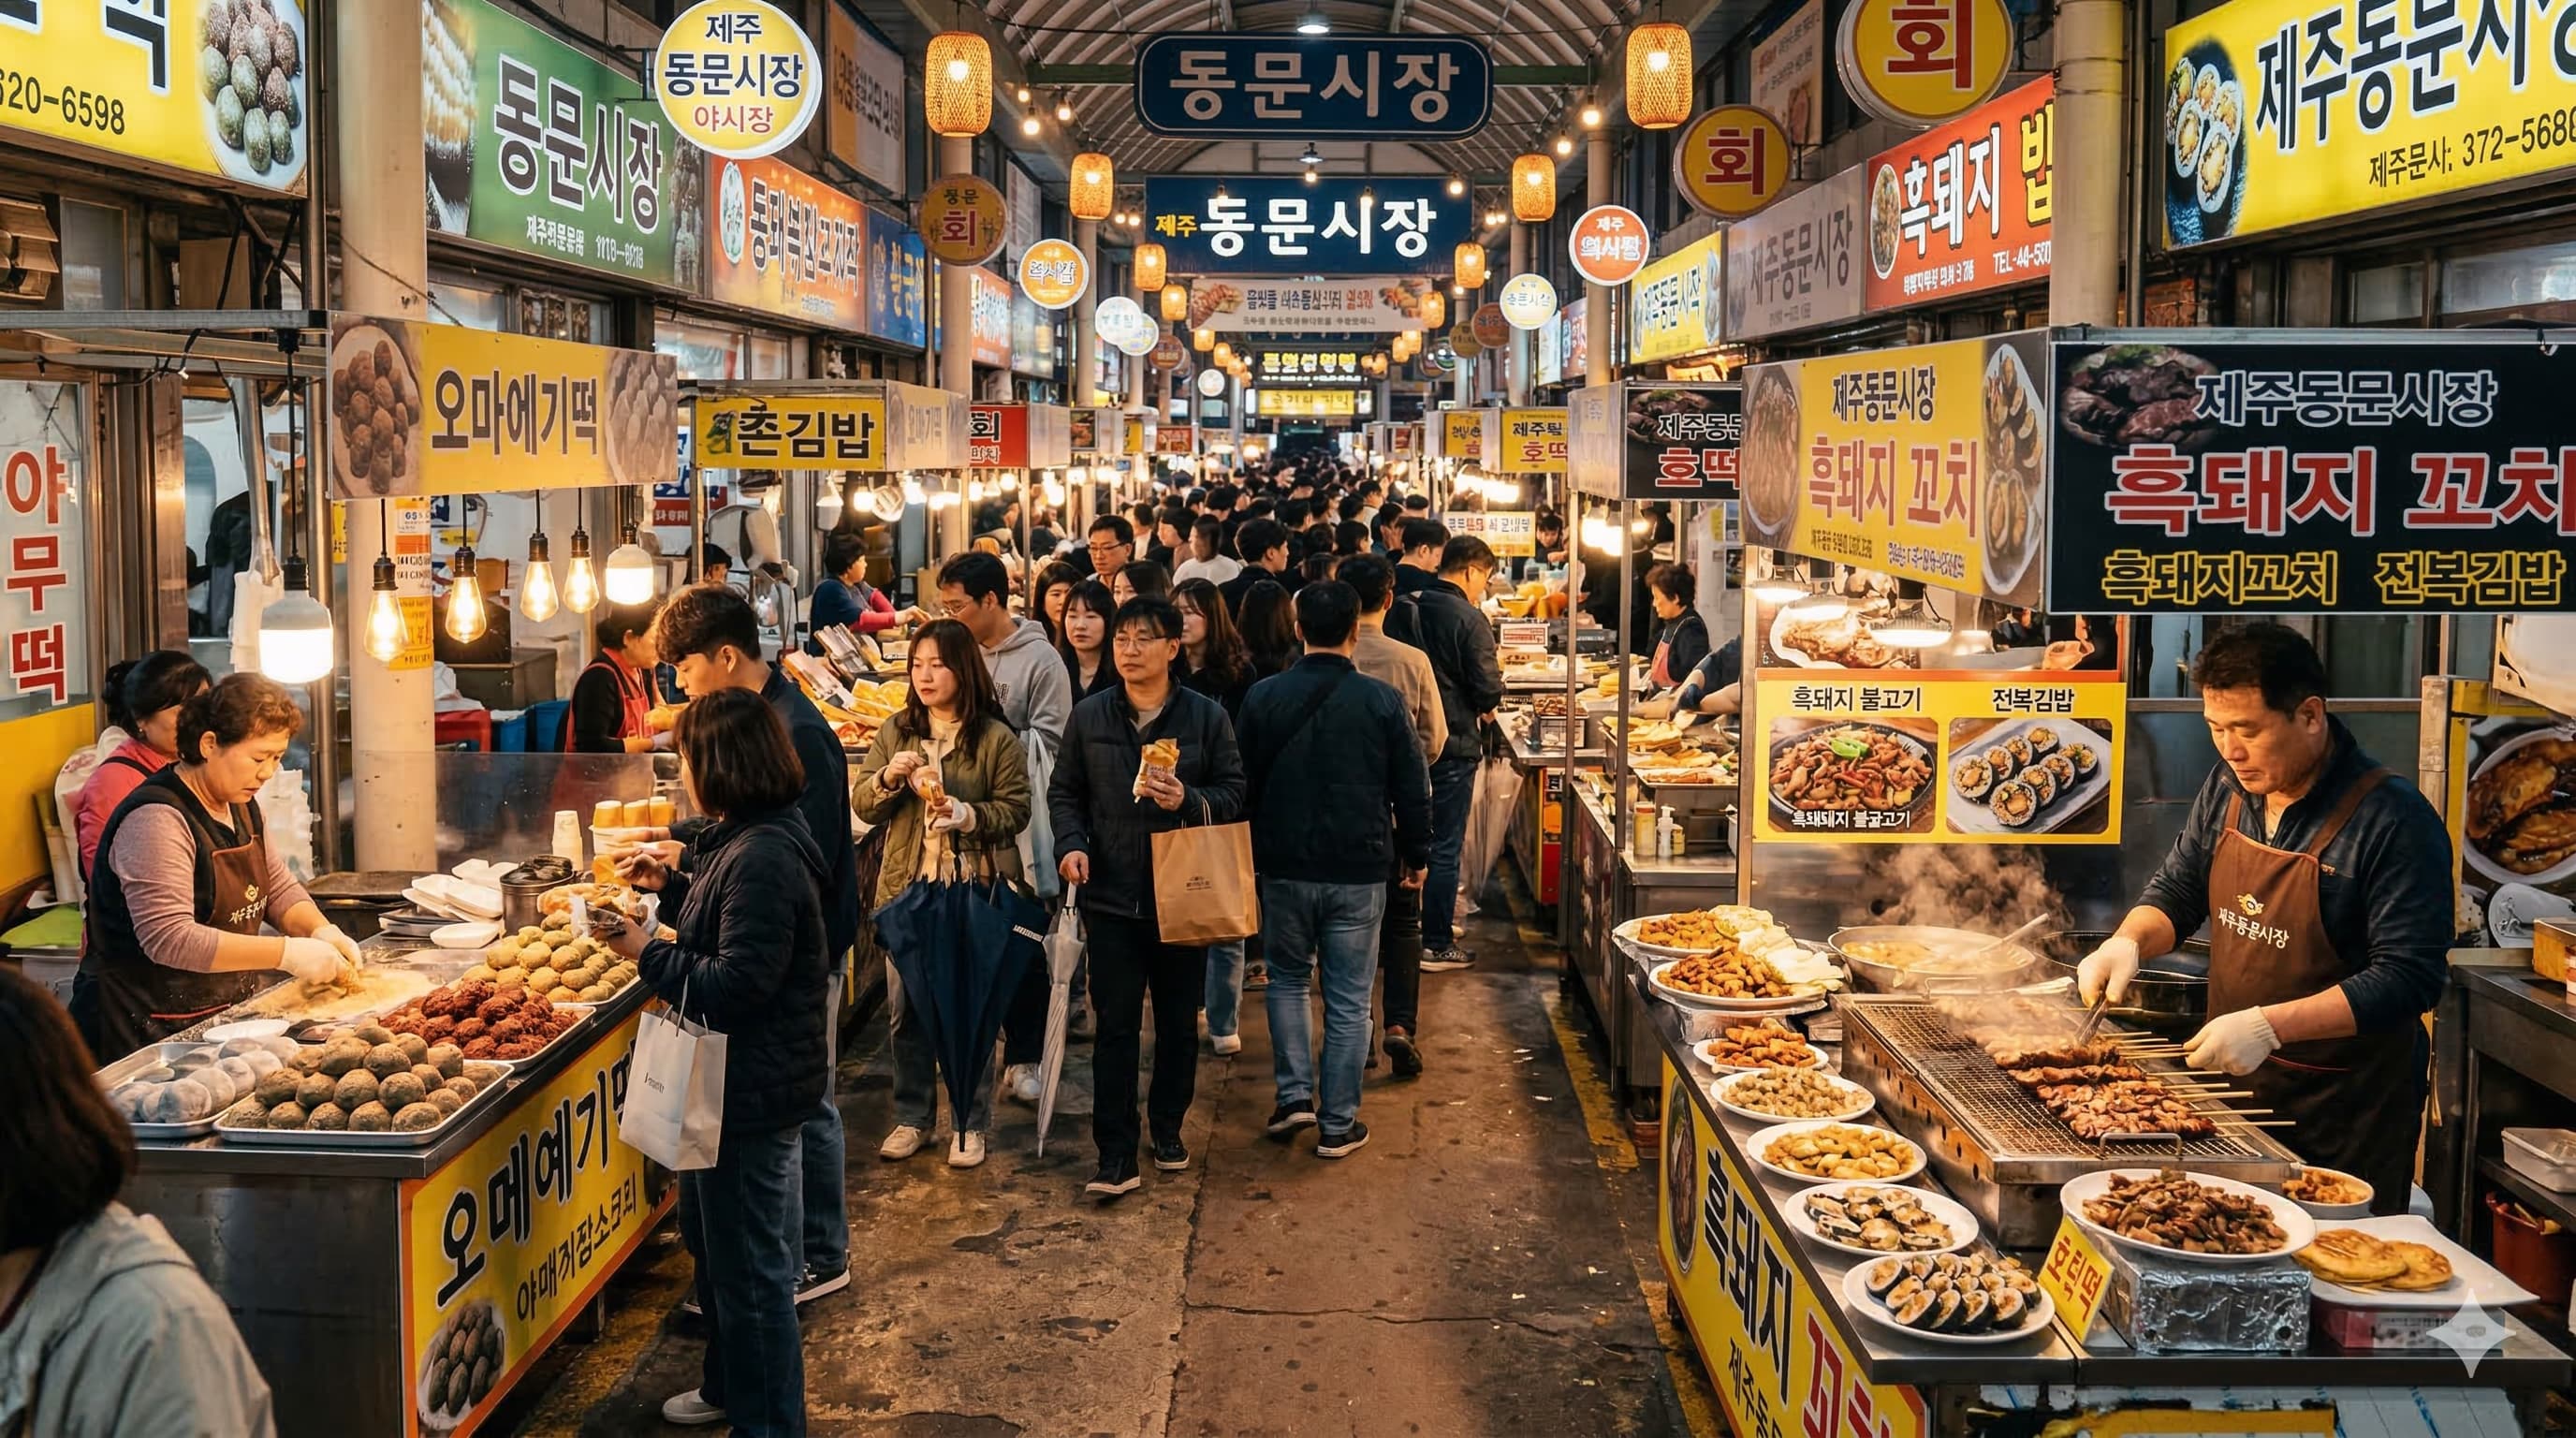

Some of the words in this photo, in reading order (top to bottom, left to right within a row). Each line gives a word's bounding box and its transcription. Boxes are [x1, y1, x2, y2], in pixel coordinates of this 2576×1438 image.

[706, 14, 762, 43] 제주
[1887, 0, 1973, 90] 회
[665, 53, 803, 97] 동문시장
[1169, 51, 1459, 123] 동문시장
[2255, 0, 2576, 151] 제주동문시
[494, 53, 663, 233] 동문시장
[695, 106, 773, 133] 야시장
[1705, 127, 1765, 196] 회
[1900, 123, 2000, 257] 흑돼지
[942, 211, 975, 247] 회
[1155, 213, 1197, 238] 제주
[1200, 198, 1437, 257] 동문시장
[1750, 203, 1853, 305] 제주동문시장
[432, 370, 597, 455] 오마에기떡
[1833, 365, 1936, 423] 제주동문시장
[2194, 369, 2498, 428] 제주동문시장
[737, 404, 875, 459] 촌김밥
[1808, 434, 1895, 527] 흑돼지
[1907, 440, 1978, 537] 꼬치
[2105, 443, 2376, 537] 흑돼지
[2402, 445, 2576, 537] 꼬치
[2100, 550, 2338, 606] 흑돼지꼬치
[2374, 550, 2567, 607] 전복김밥
[1792, 686, 1853, 712] 흑돼지
[1859, 686, 1923, 712] 불고기
[1992, 687, 2075, 712] 전복김밥
[1705, 1146, 1793, 1406] 흑돼지
